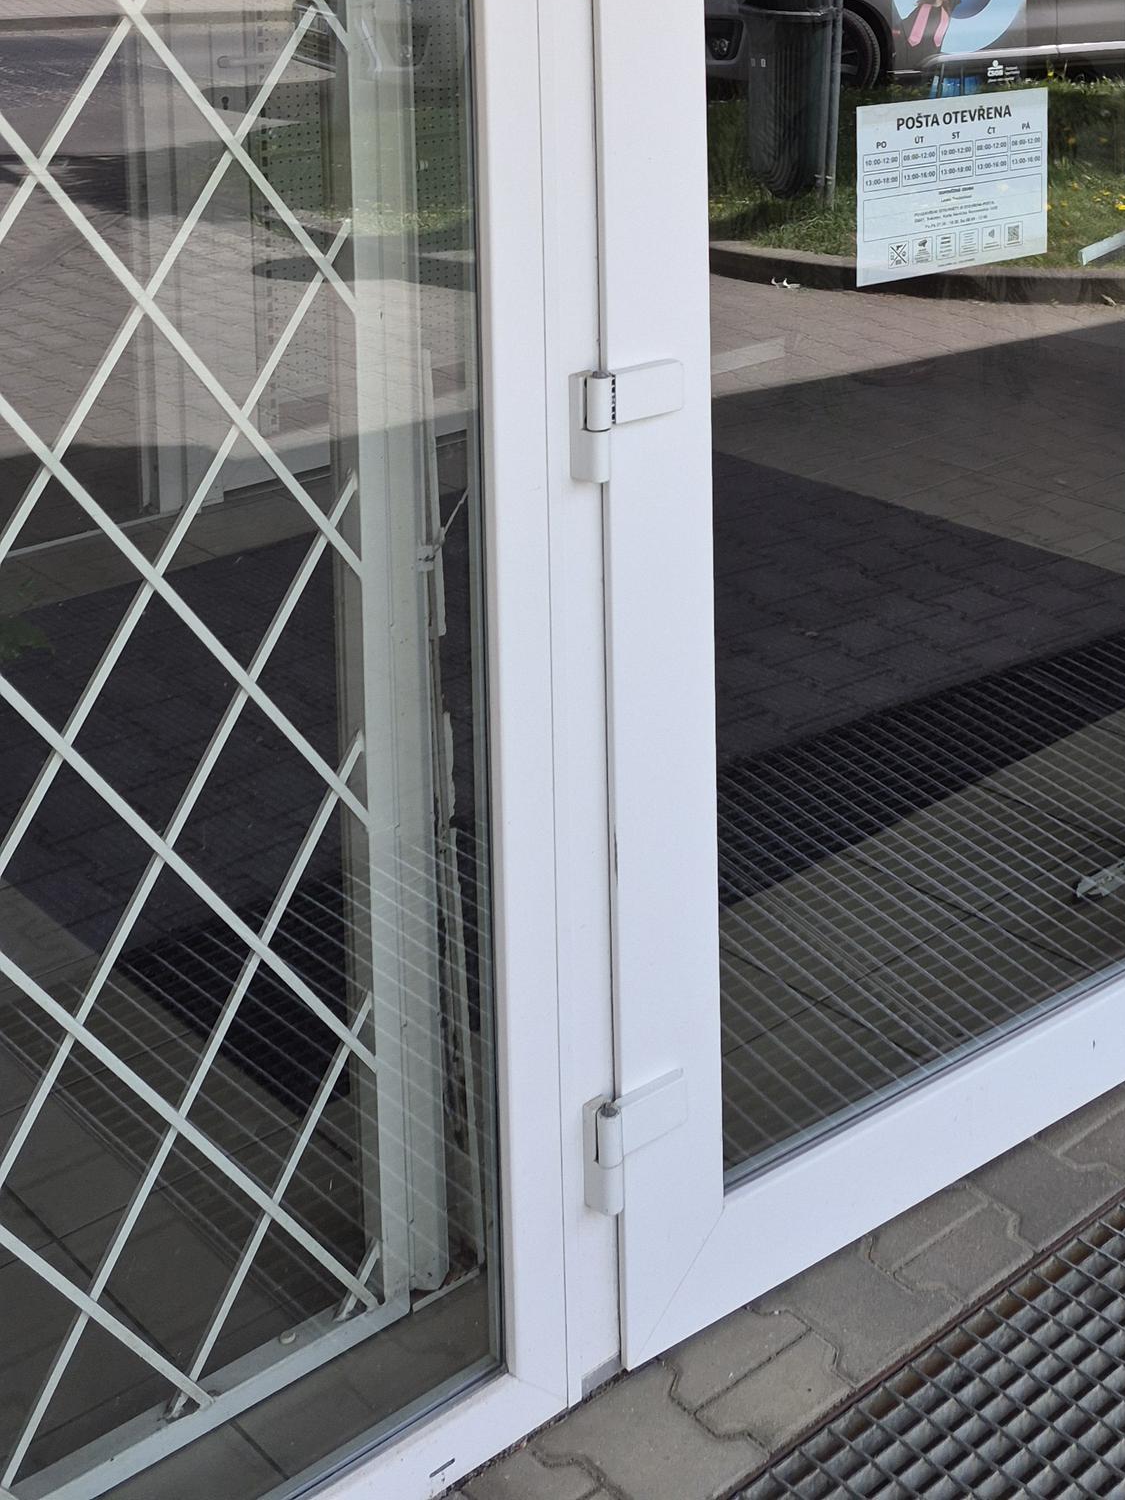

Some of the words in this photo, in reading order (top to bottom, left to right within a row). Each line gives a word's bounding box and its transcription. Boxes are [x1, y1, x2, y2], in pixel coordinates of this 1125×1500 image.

[896, 113, 940, 131] POŠTA
[943, 105, 1012, 125] OTEVŘENA
[876, 141, 887, 149] PO
[914, 135, 924, 144] ÚT
[952, 131, 960, 139] ST
[987, 126, 996, 134] ČT
[1021, 121, 1031, 130] PÁ
